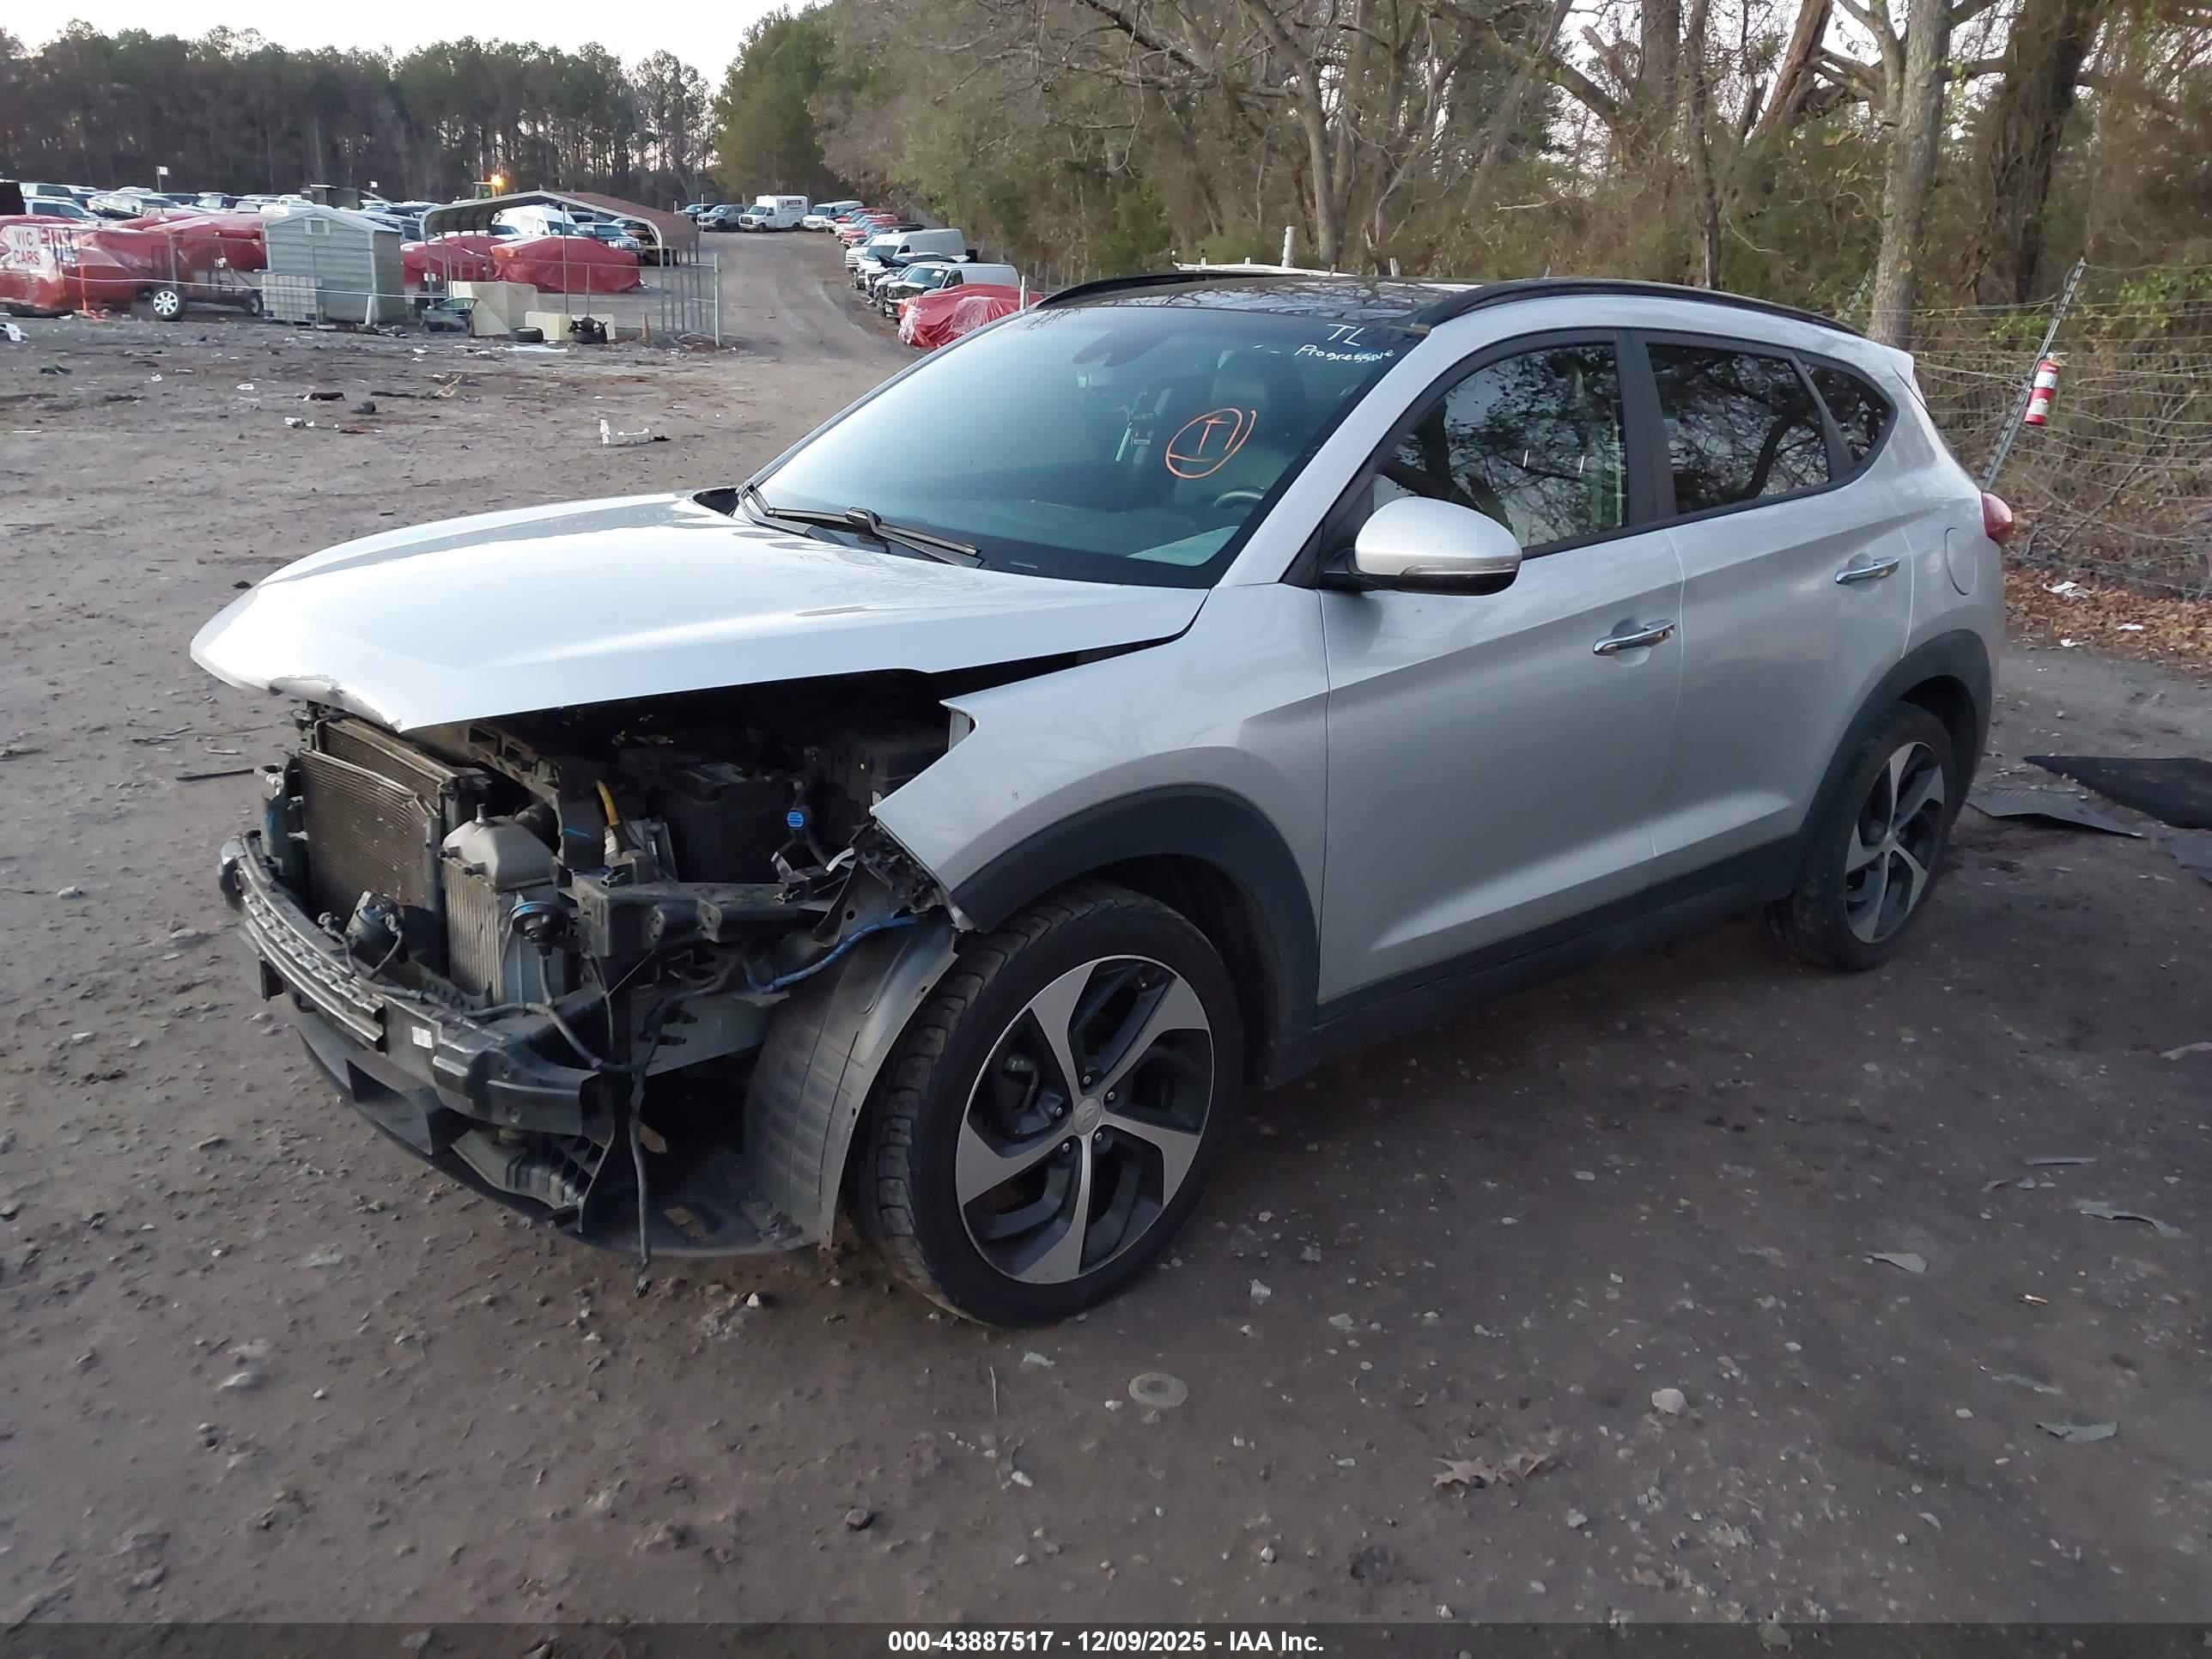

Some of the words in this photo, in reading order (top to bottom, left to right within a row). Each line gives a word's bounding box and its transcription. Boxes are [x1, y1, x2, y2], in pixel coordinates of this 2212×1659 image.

[14, 231, 33, 246] VIC
[14, 250, 40, 265] CARS
[1326, 323, 1365, 347] TL
[1294, 343, 1395, 363] Progressive
